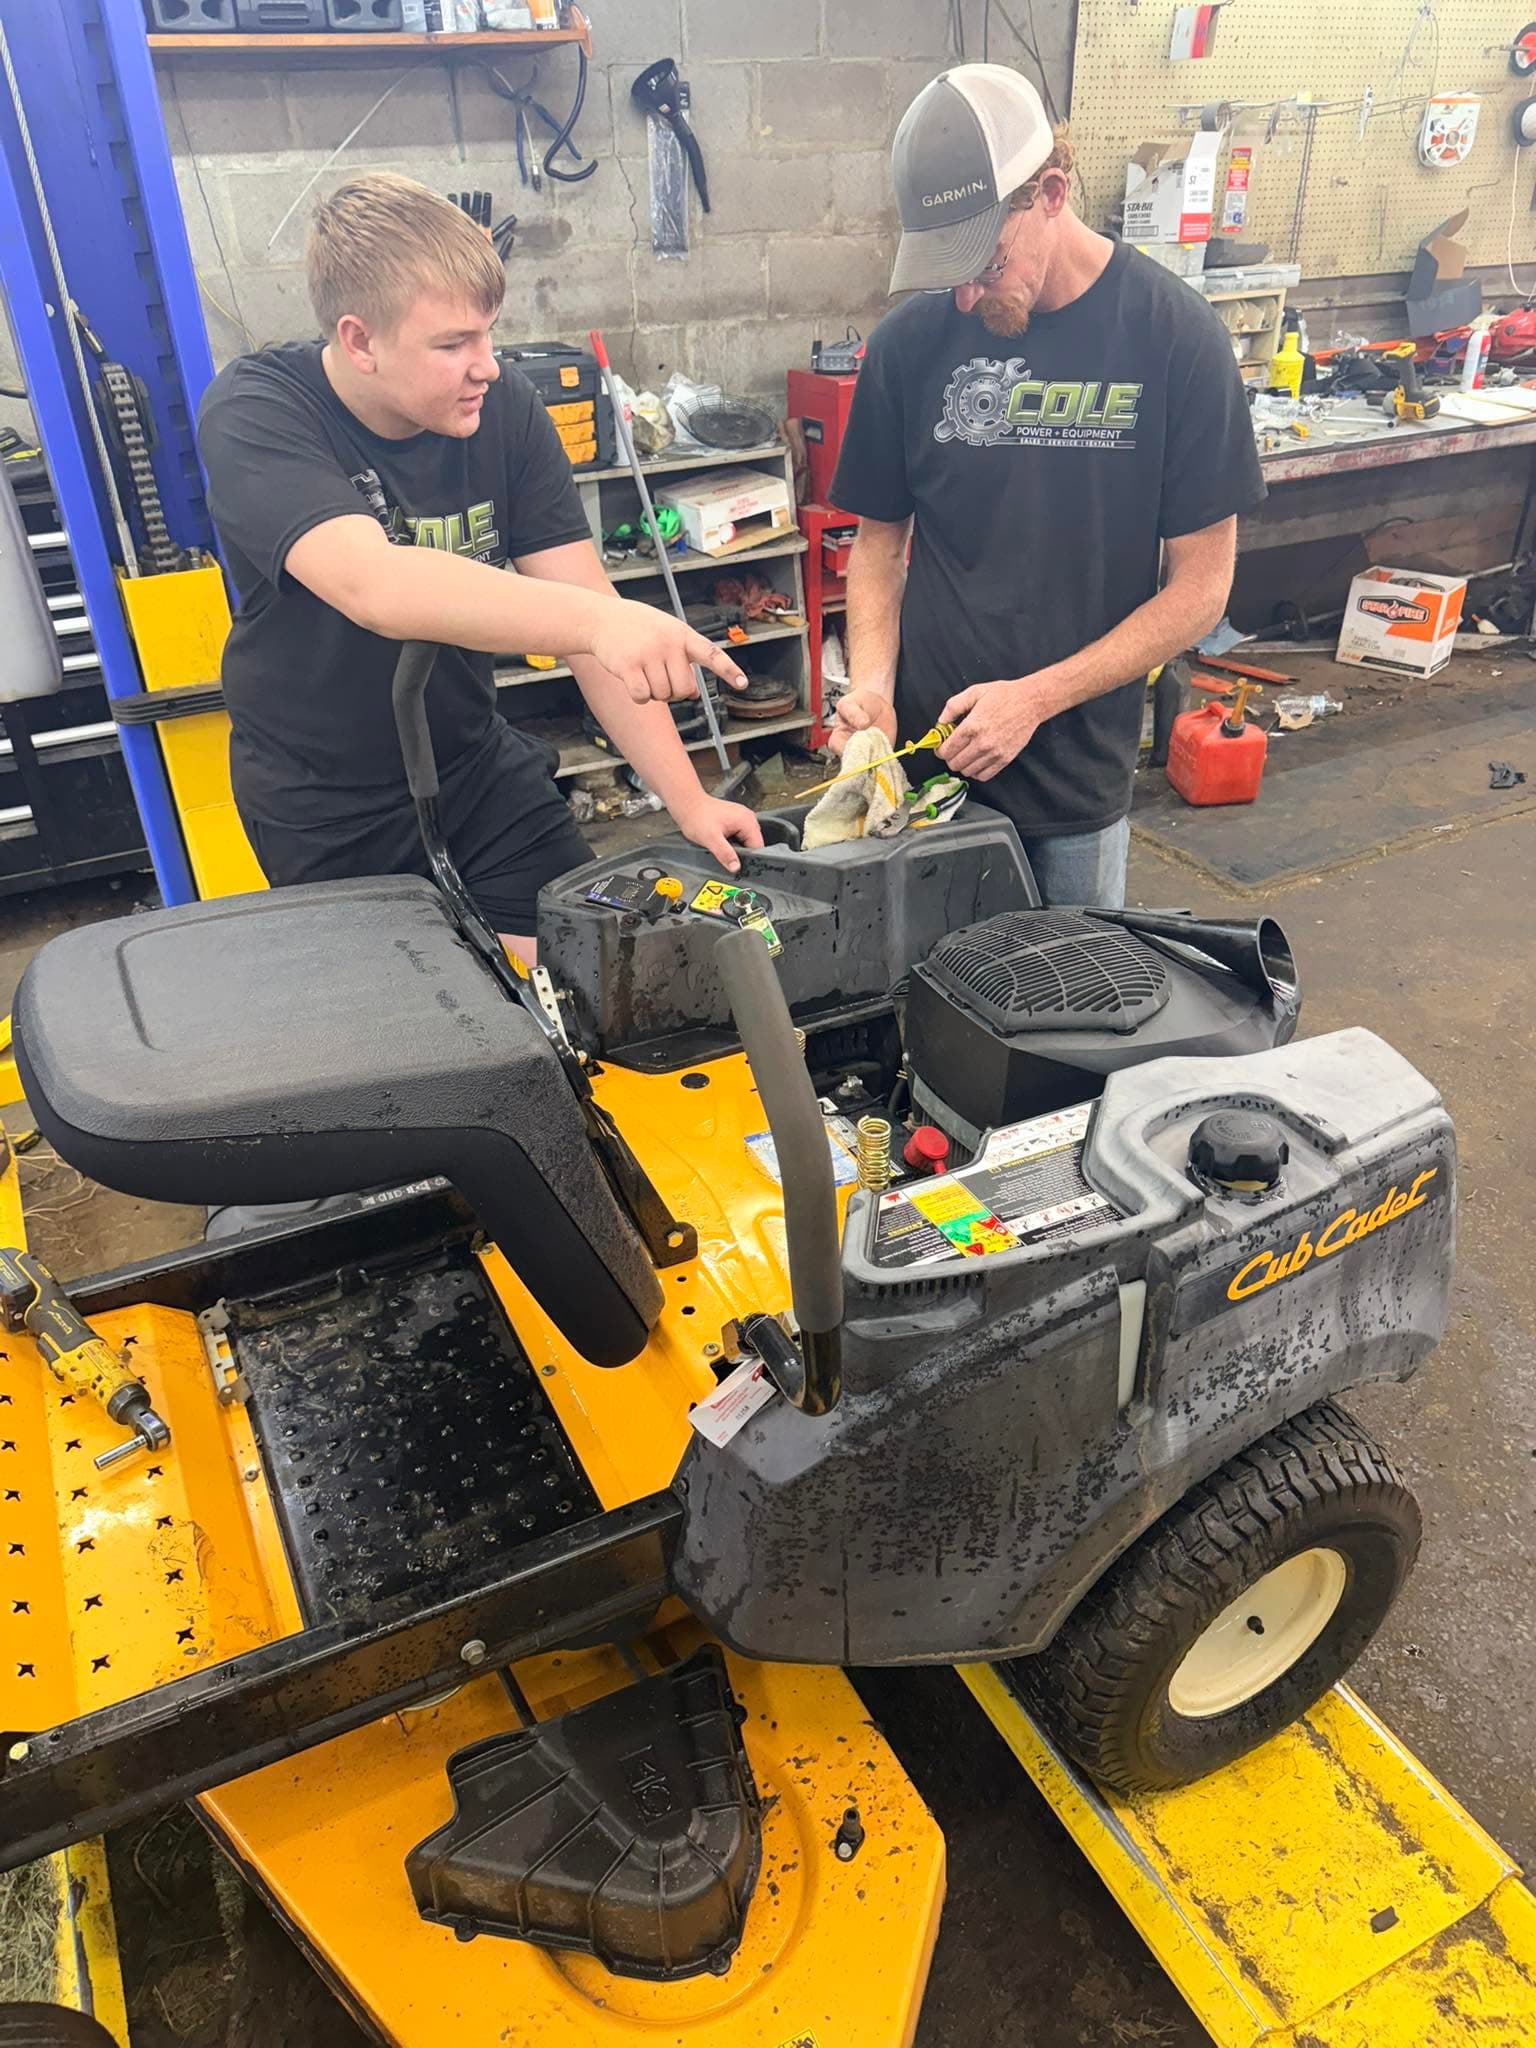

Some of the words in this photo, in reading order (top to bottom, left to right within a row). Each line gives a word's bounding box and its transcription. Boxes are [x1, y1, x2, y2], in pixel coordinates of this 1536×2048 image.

[1006, 381, 1143, 428] COLE
[1016, 426, 1053, 438] POWER
[1062, 428, 1122, 440] EQUIPMENT
[1226, 1231, 1313, 1301] Cub
[1315, 1167, 1438, 1258] Cadet
